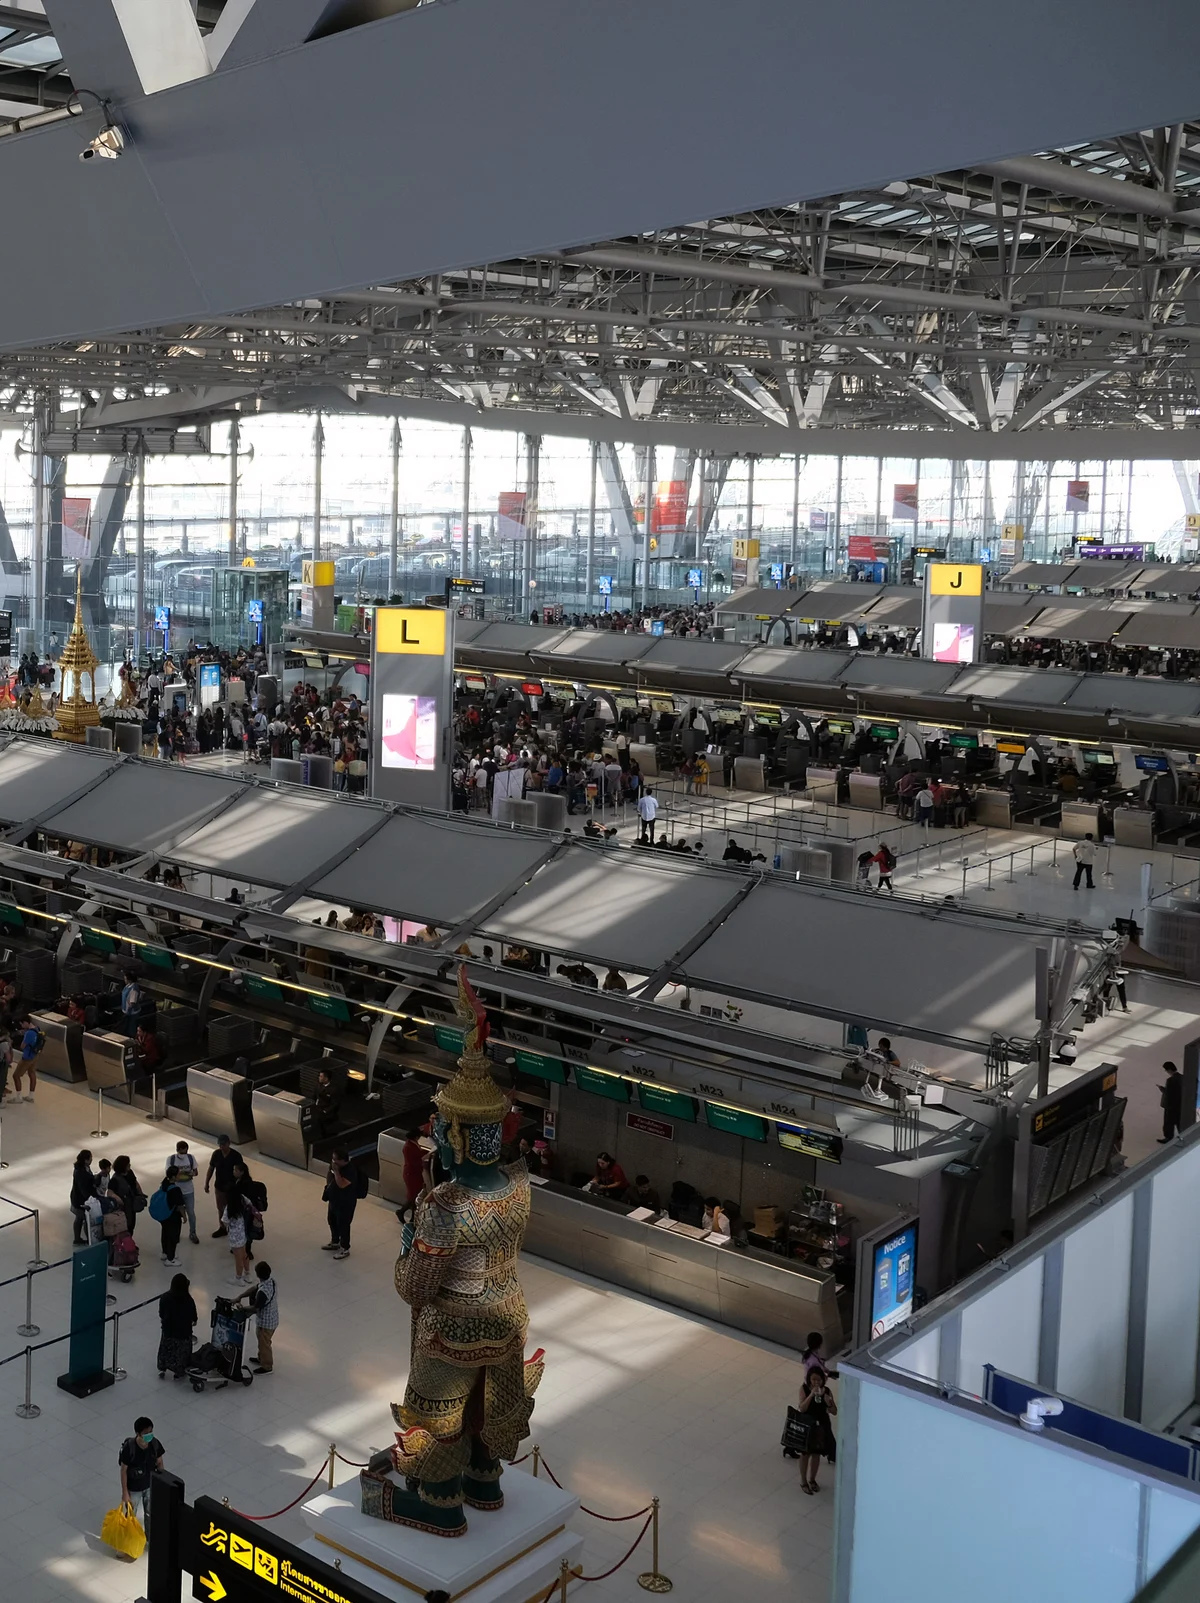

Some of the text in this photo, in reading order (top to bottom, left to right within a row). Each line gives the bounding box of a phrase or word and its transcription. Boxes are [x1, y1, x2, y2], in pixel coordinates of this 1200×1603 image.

[1005, 526, 1012, 539] F
[303, 563, 312, 583] K
[950, 571, 963, 589] J
[401, 619, 420, 645] L
[426, 1009, 447, 1022] M19
[507, 1031, 529, 1044] M20
[567, 1048, 589, 1061] M21
[631, 1064, 656, 1079] M22
[699, 1083, 724, 1097] M23
[770, 1102, 797, 1117] M24
[883, 1234, 907, 1255] Notice
